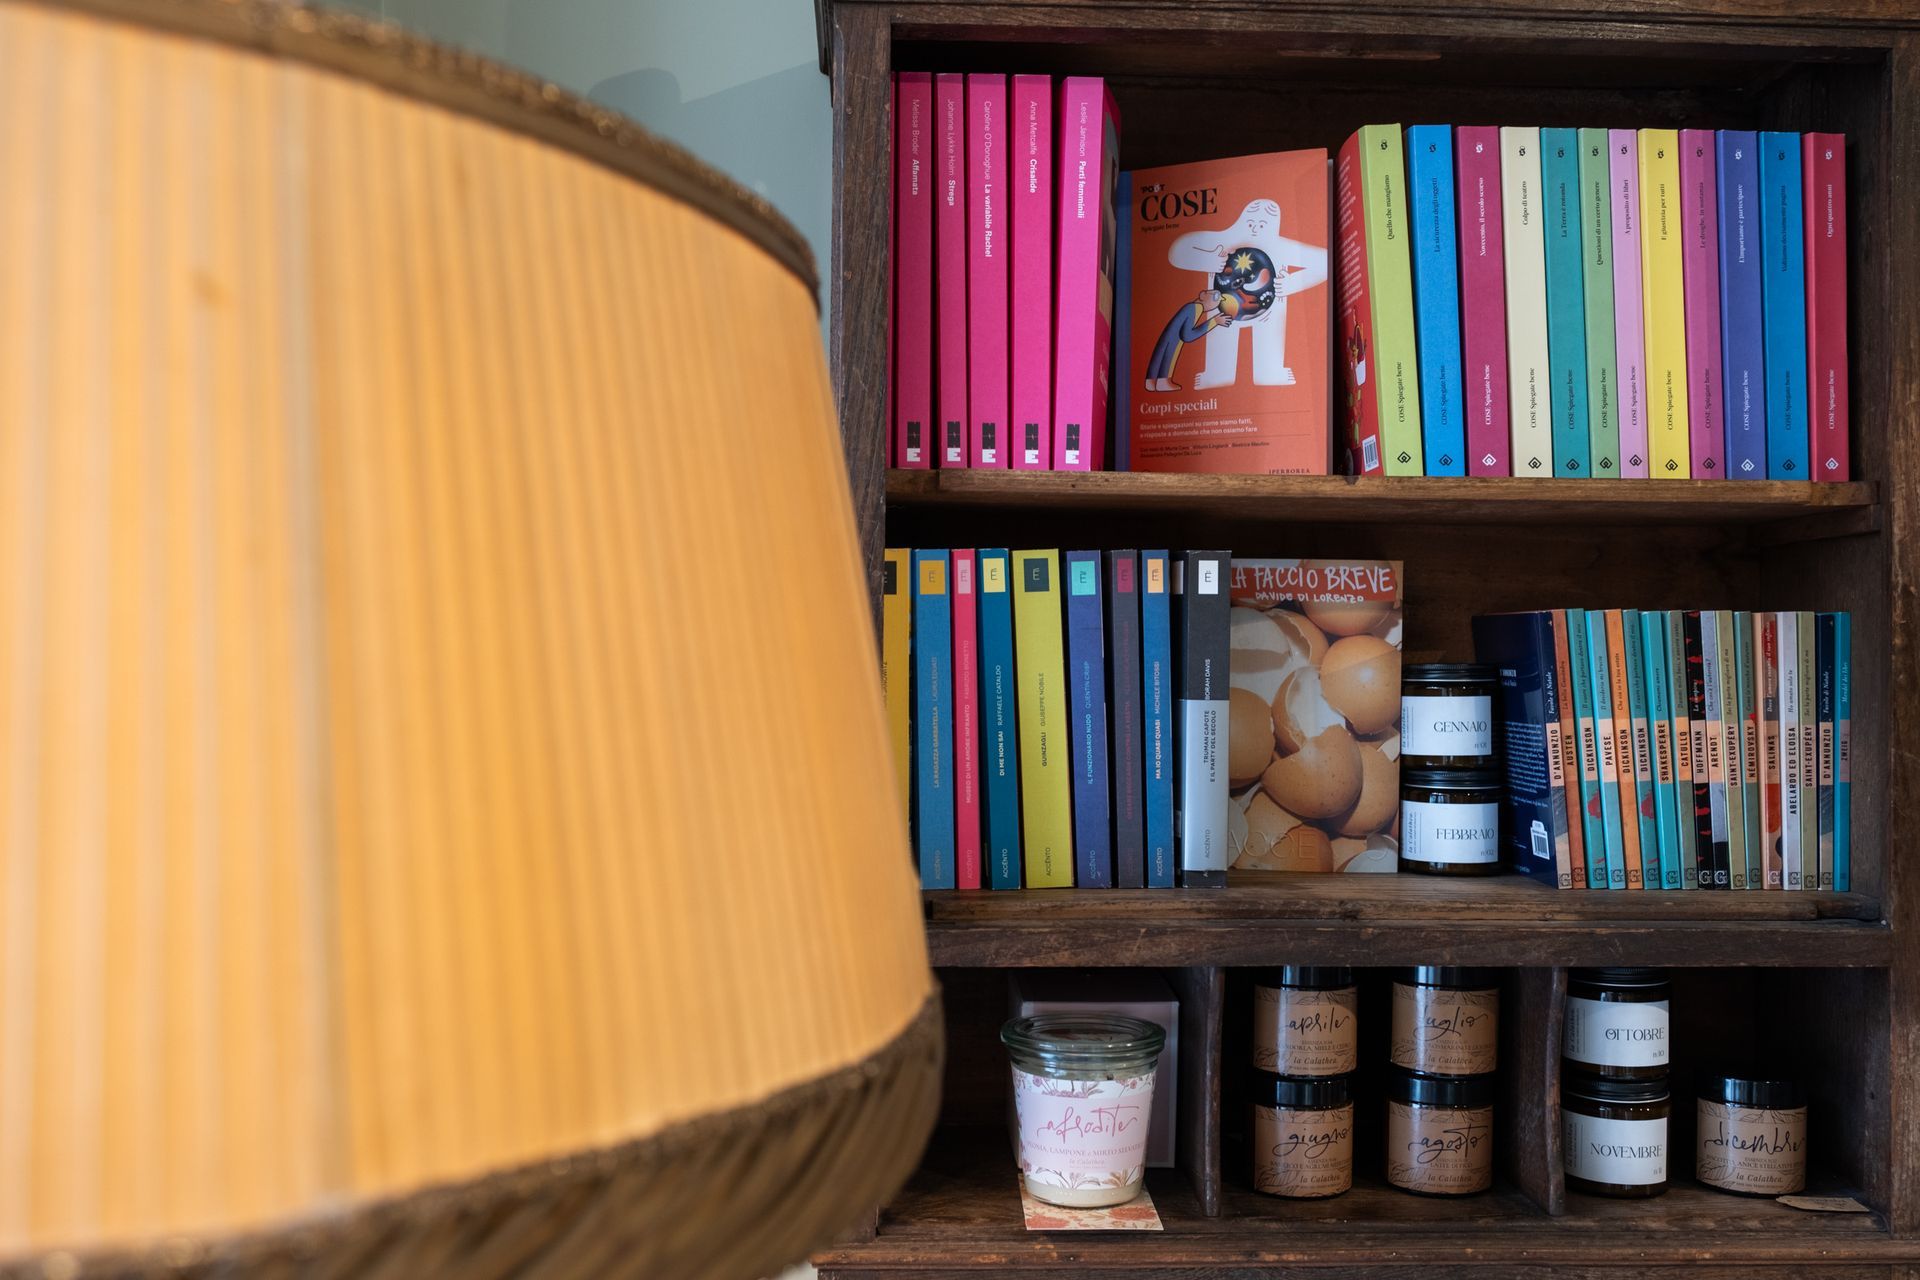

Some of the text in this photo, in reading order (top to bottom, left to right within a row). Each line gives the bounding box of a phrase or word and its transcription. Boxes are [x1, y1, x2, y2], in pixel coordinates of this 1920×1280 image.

[912, 99, 920, 195] Melissa Broder Affamata
[946, 98, 956, 206] Johanne Lykke Holm Strega
[1029, 100, 1038, 194] Anna Metcalfe Crisalide
[1076, 102, 1088, 218] Leslie Jamison Parti femminili
[982, 100, 992, 258] Caroline O'Donoghue La variabile Rachel
[1141, 187, 1218, 222] COSE
[1384, 174, 1396, 240] Quello che mangiamo
[1522, 208, 1530, 226] Colpo
[1826, 184, 1834, 238] Ogni quattro anni
[1140, 398, 1217, 416] Corpi speciali
[1396, 406, 1406, 424] COSE
[1484, 406, 1492, 426] COSE
[1528, 410, 1538, 428] COSE
[1600, 410, 1608, 428] COSE
[1630, 408, 1638, 426] COSE
[1664, 412, 1674, 430] COSE
[1742, 412, 1750, 430] COSE
[1827, 412, 1836, 430] COSE
[1254, 566, 1318, 591] FACCIO
[1324, 565, 1394, 593] BREVE
[1255, 592, 1364, 604] DAVIDE DI LORENZO
[1038, 672, 1046, 696] NOBILE
[1546, 672, 1554, 690] Natale
[1038, 696, 1046, 726] GIUSEPPE
[1546, 697, 1554, 714] Favole
[998, 730, 1006, 742] SAI
[1086, 713, 1094, 733] NUDO
[1433, 720, 1488, 733] GENNAIO
[963, 738, 972, 760] AMORE
[998, 743, 1006, 757] NON
[1086, 734, 1094, 778] FUNZIONARIO
[1550, 729, 1562, 780] D'ANNUNZIO
[1564, 734, 1574, 766] AUSTEN
[1584, 726, 1596, 772] DICKINSON
[1602, 736, 1614, 766] PAVESE
[1620, 728, 1630, 774] DICKINSON
[1638, 728, 1648, 772] DICKINSON
[1658, 724, 1670, 782] SHAKESPEARE
[1680, 730, 1690, 767] CATULLO
[1694, 730, 1704, 774] HOFFMANN
[1710, 736, 1720, 768] ARENDT
[1726, 726, 1738, 787] SAINT-EXUPÉRY
[1746, 726, 1756, 778] NÉMIROVSKY
[1767, 734, 1777, 770] SALINAS
[1804, 726, 1814, 788] SAINT-EXUPÉRY
[1822, 728, 1832, 779] D'ANNUNZIO
[1840, 740, 1848, 761] ZWEIG
[963, 762, 972, 772] UN
[998, 758, 1006, 768] ME
[998, 768, 1006, 776] DI
[1154, 760, 1162, 768] IO
[1154, 768, 1162, 780] MA
[1788, 726, 1798, 815] ABELARDO ED ELOISA
[963, 780, 972, 804] MUSEO
[1436, 828, 1496, 841] FEBBRAIO
[1286, 1007, 1350, 1035] aprile
[1412, 1005, 1489, 1042] luglio
[1604, 1027, 1665, 1042] OTTOBRE
[1037, 1104, 1140, 1144] afrodite
[1704, 1121, 1806, 1155] dicembre
[1271, 1128, 1351, 1159] giugno
[1408, 1123, 1489, 1164] agosto
[1590, 1143, 1663, 1159] NOVEMBRE
[1737, 1172, 1745, 1180] la
